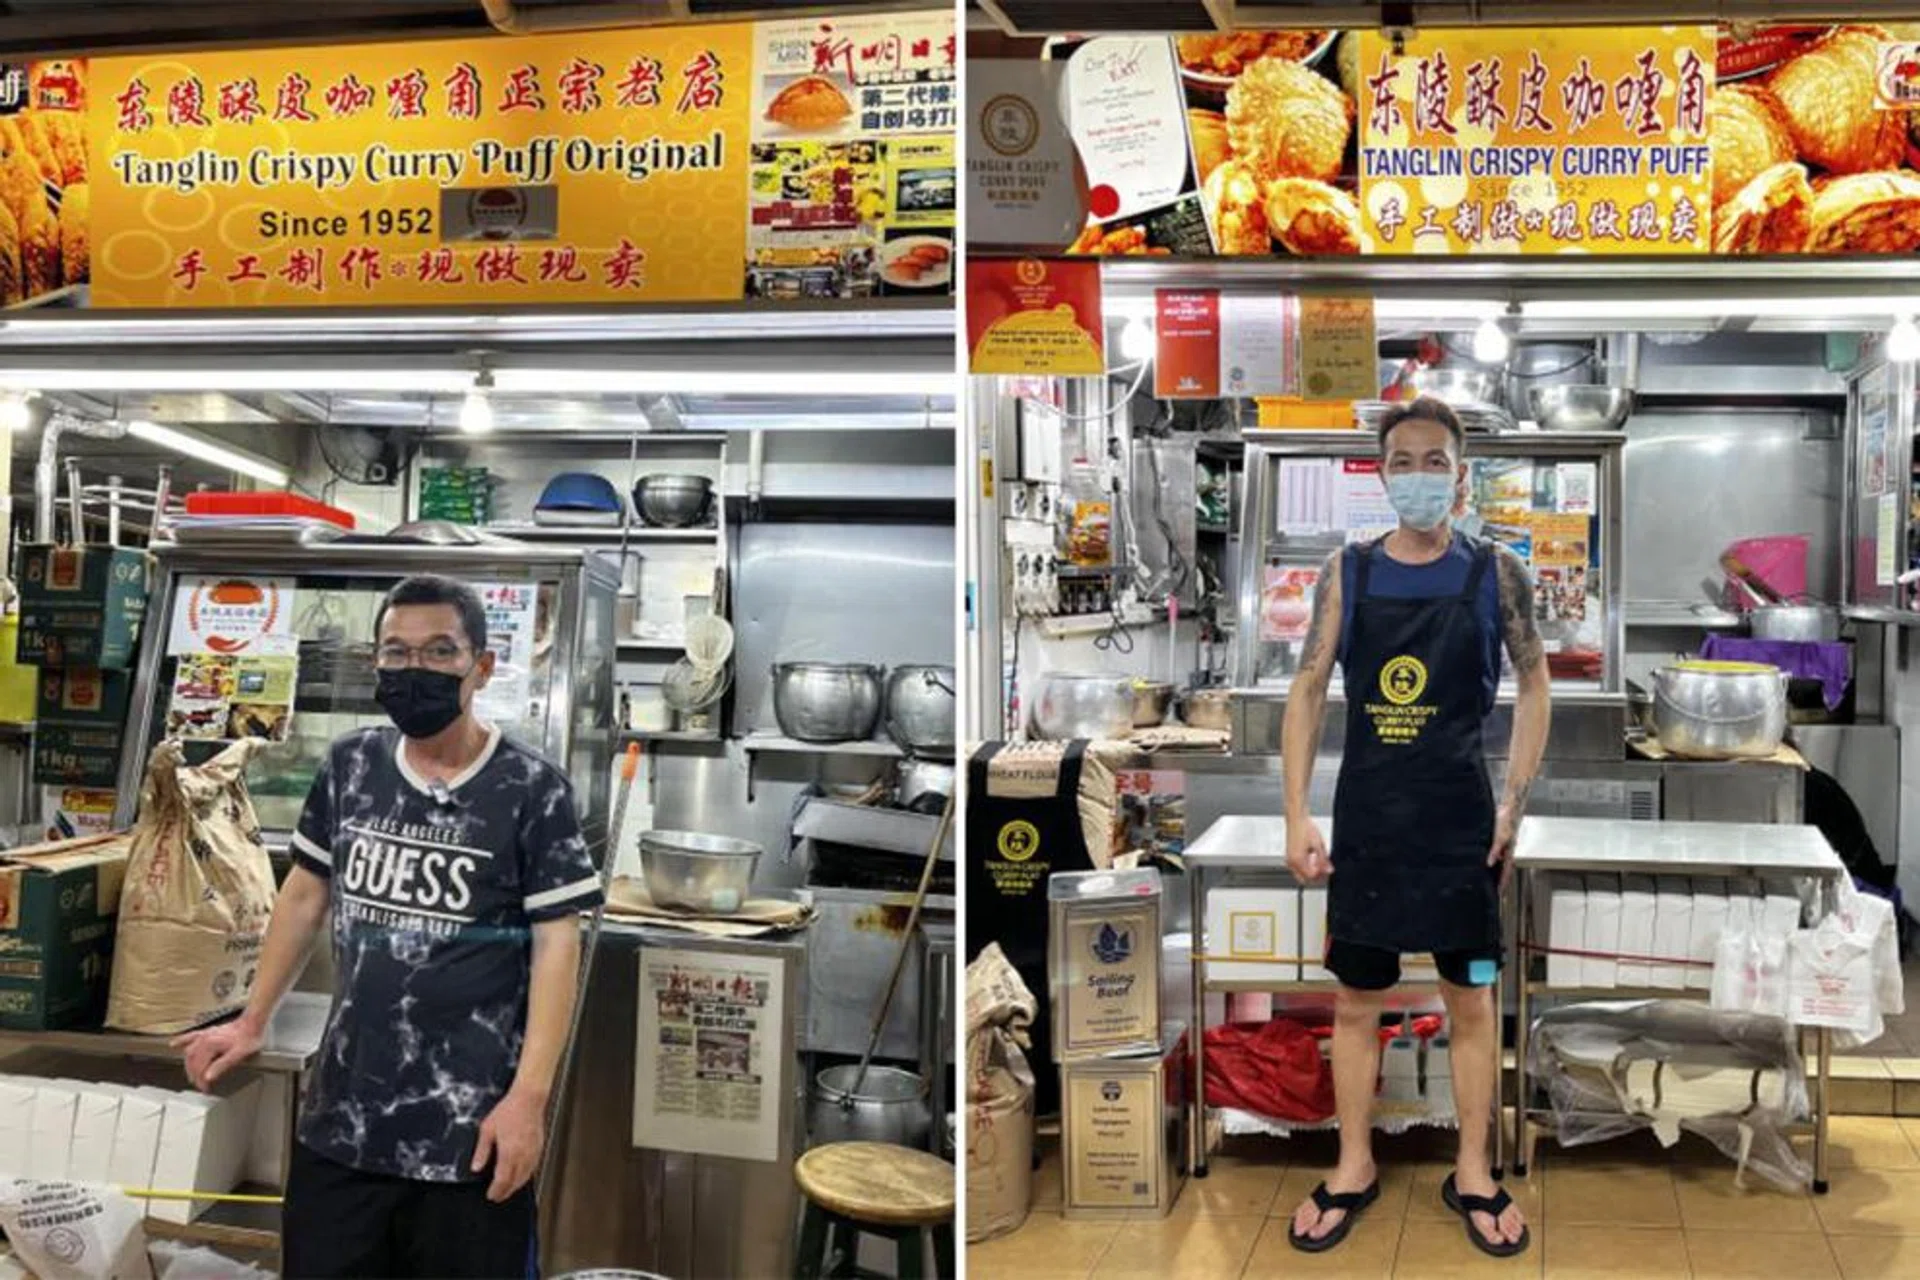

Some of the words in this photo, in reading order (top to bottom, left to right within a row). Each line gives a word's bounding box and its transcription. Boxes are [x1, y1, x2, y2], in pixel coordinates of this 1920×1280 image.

[116, 51, 723, 131] 东陵酥皮咖喱角正宗老店
[1368, 47, 1706, 137] 东陵酥皮咖喱角
[112, 150, 240, 192] Tanglin
[248, 148, 356, 189] Crispy
[365, 143, 466, 186] Curry
[472, 138, 558, 182] Puff
[565, 132, 723, 178] Original
[1363, 147, 1462, 177] TANGLIN
[1470, 146, 1555, 176] CRISPY
[1562, 146, 1641, 176] CURRY
[1649, 144, 1709, 176] PUFF
[1476, 181, 1536, 197] Since
[1546, 181, 1588, 197] 1952
[259, 210, 348, 238] Since
[359, 207, 432, 235] 1952
[343, 837, 476, 911] GUESS
